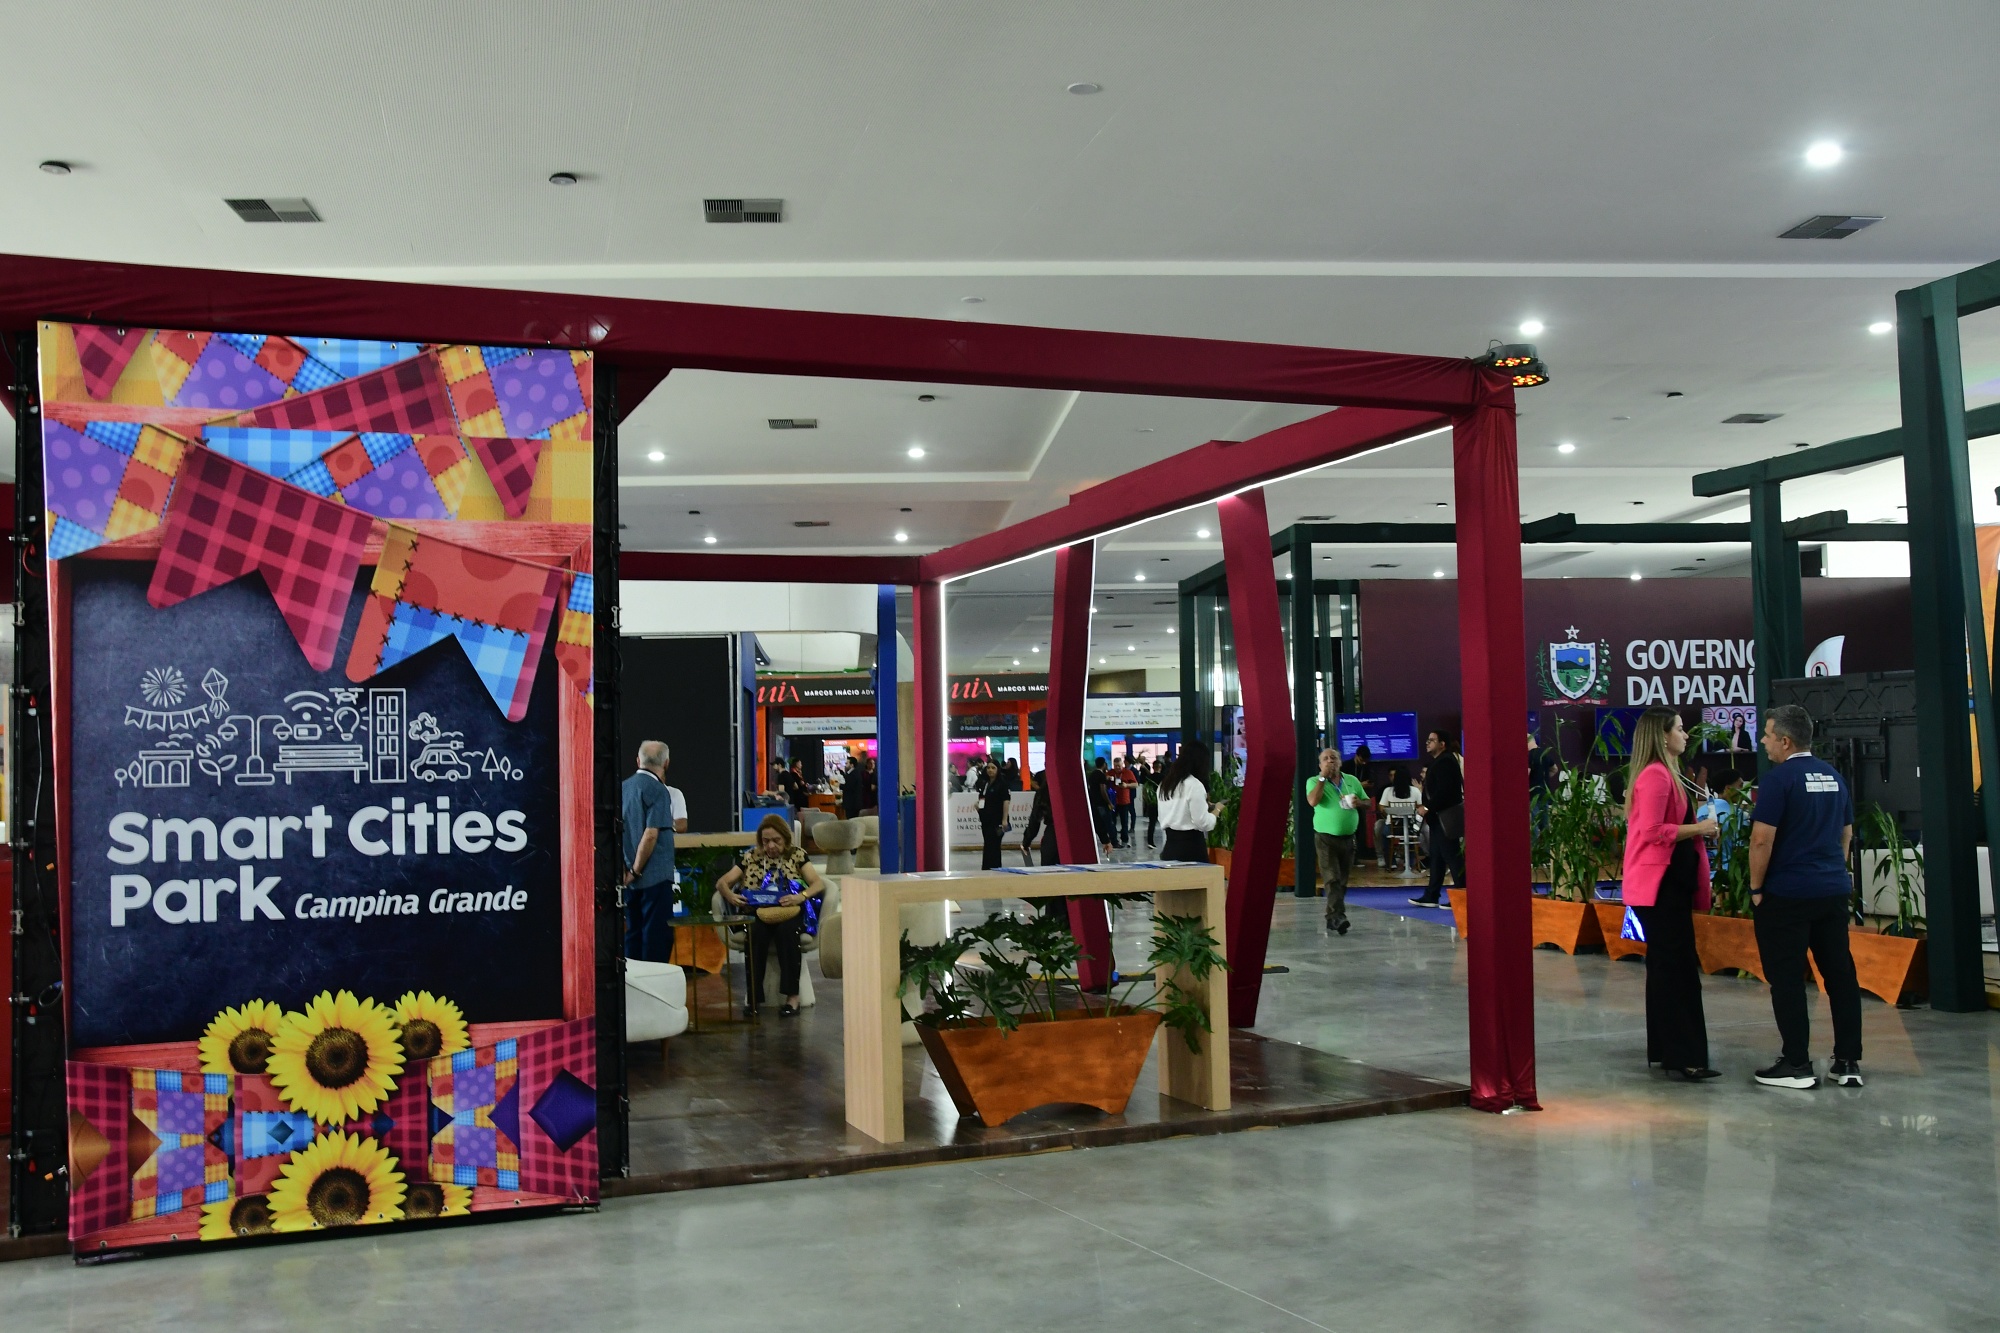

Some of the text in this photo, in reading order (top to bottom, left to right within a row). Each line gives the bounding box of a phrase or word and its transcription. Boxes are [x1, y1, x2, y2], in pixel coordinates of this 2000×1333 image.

[835, 688, 860, 696] INÁCIO
[1626, 668, 1755, 706] DA PARAÍ
[106, 796, 528, 865] Smart Cities
[109, 865, 528, 927] Park Campina Grande
